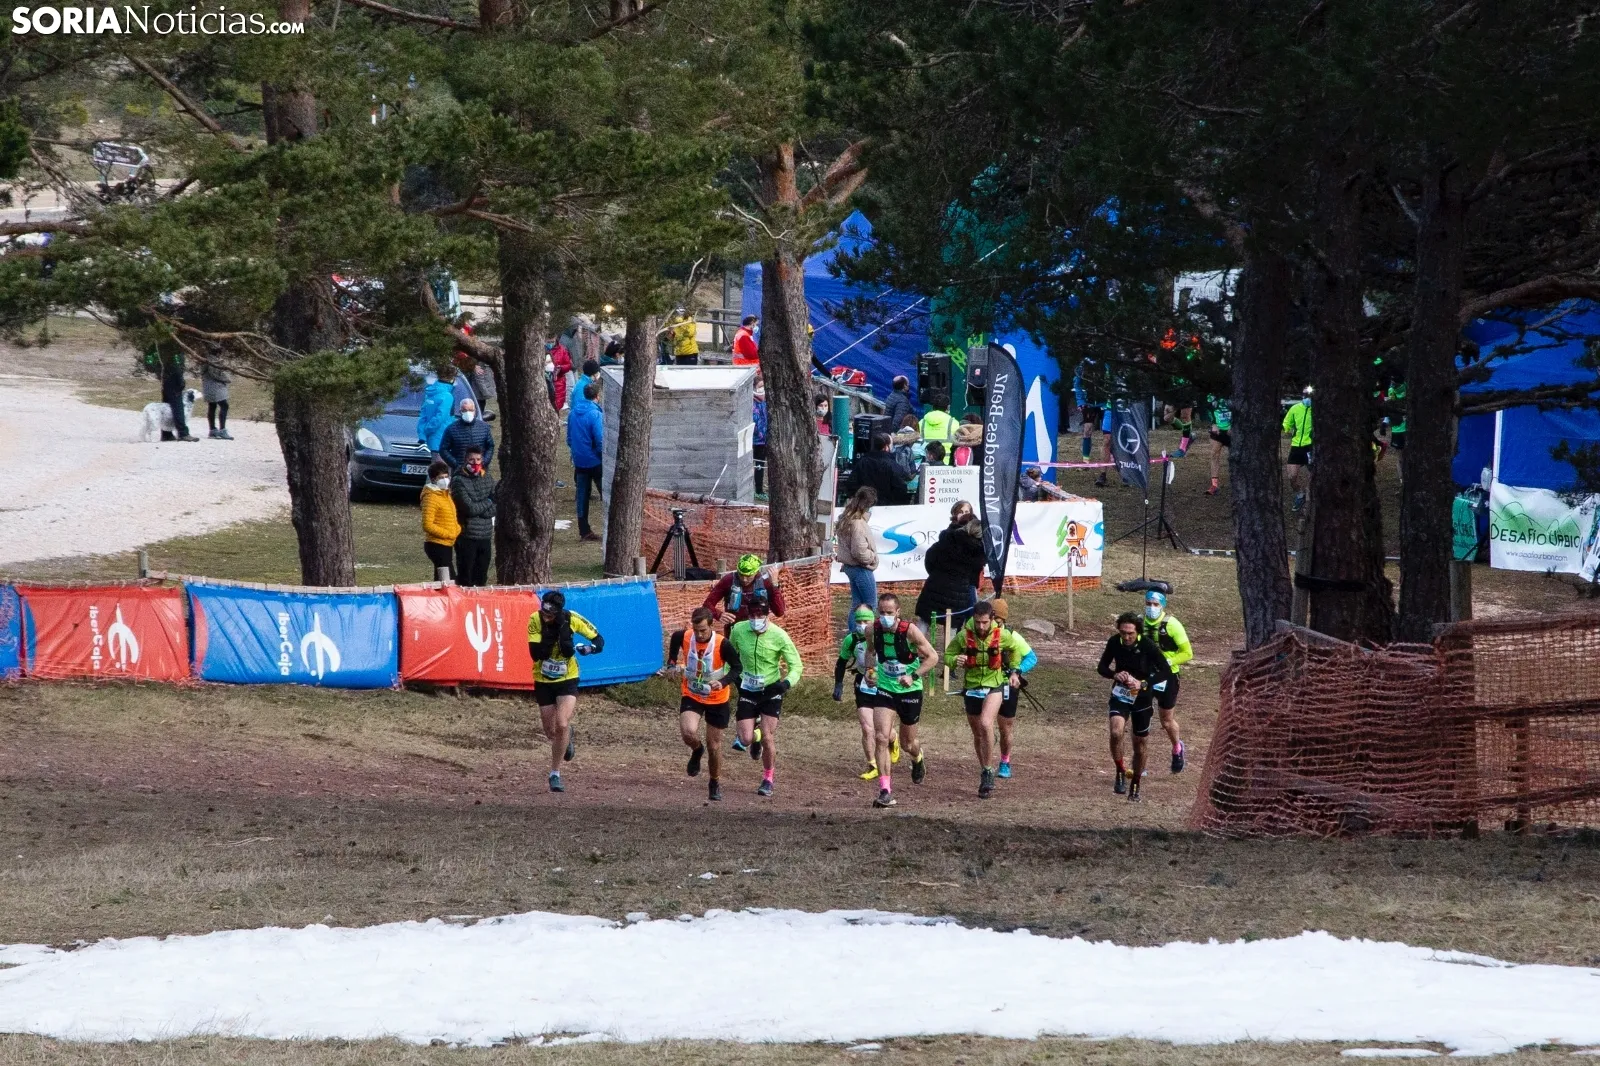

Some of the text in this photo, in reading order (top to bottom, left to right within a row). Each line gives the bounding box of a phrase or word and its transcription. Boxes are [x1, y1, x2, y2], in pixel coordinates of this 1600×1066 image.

[407, 465, 427, 474] 2822
[876, 519, 938, 555] SOR
[89, 605, 103, 670] iberCaja
[277, 611, 294, 676] iberCaja
[494, 608, 504, 672] iberCaja
